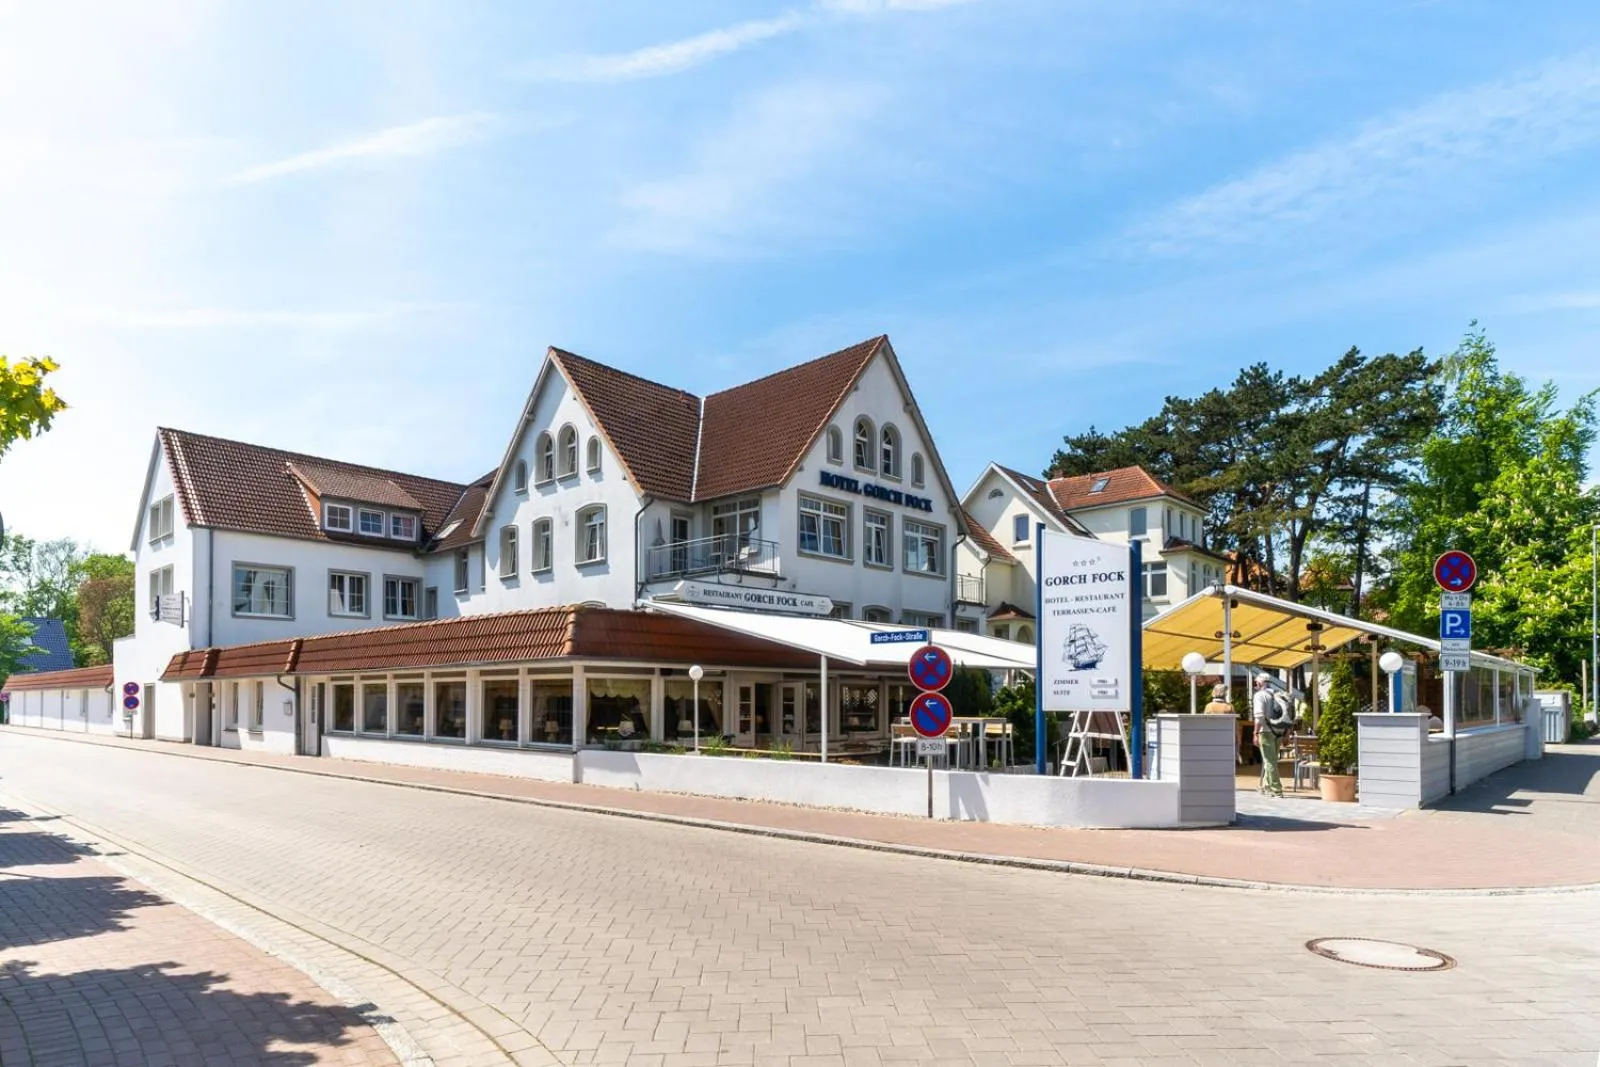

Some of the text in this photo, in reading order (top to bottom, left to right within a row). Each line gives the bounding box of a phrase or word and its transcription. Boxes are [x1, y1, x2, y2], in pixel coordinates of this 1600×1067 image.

[819, 470, 933, 513] HOTEL GORCH FOCK
[1045, 571, 1125, 587] GORCH FOCK
[703, 589, 743, 600] RESTAURANT
[744, 592, 774, 605] GORCH
[776, 596, 798, 607] FOCK
[1075, 592, 1125, 602] RESTAURANT
[1446, 613, 1462, 635] P
